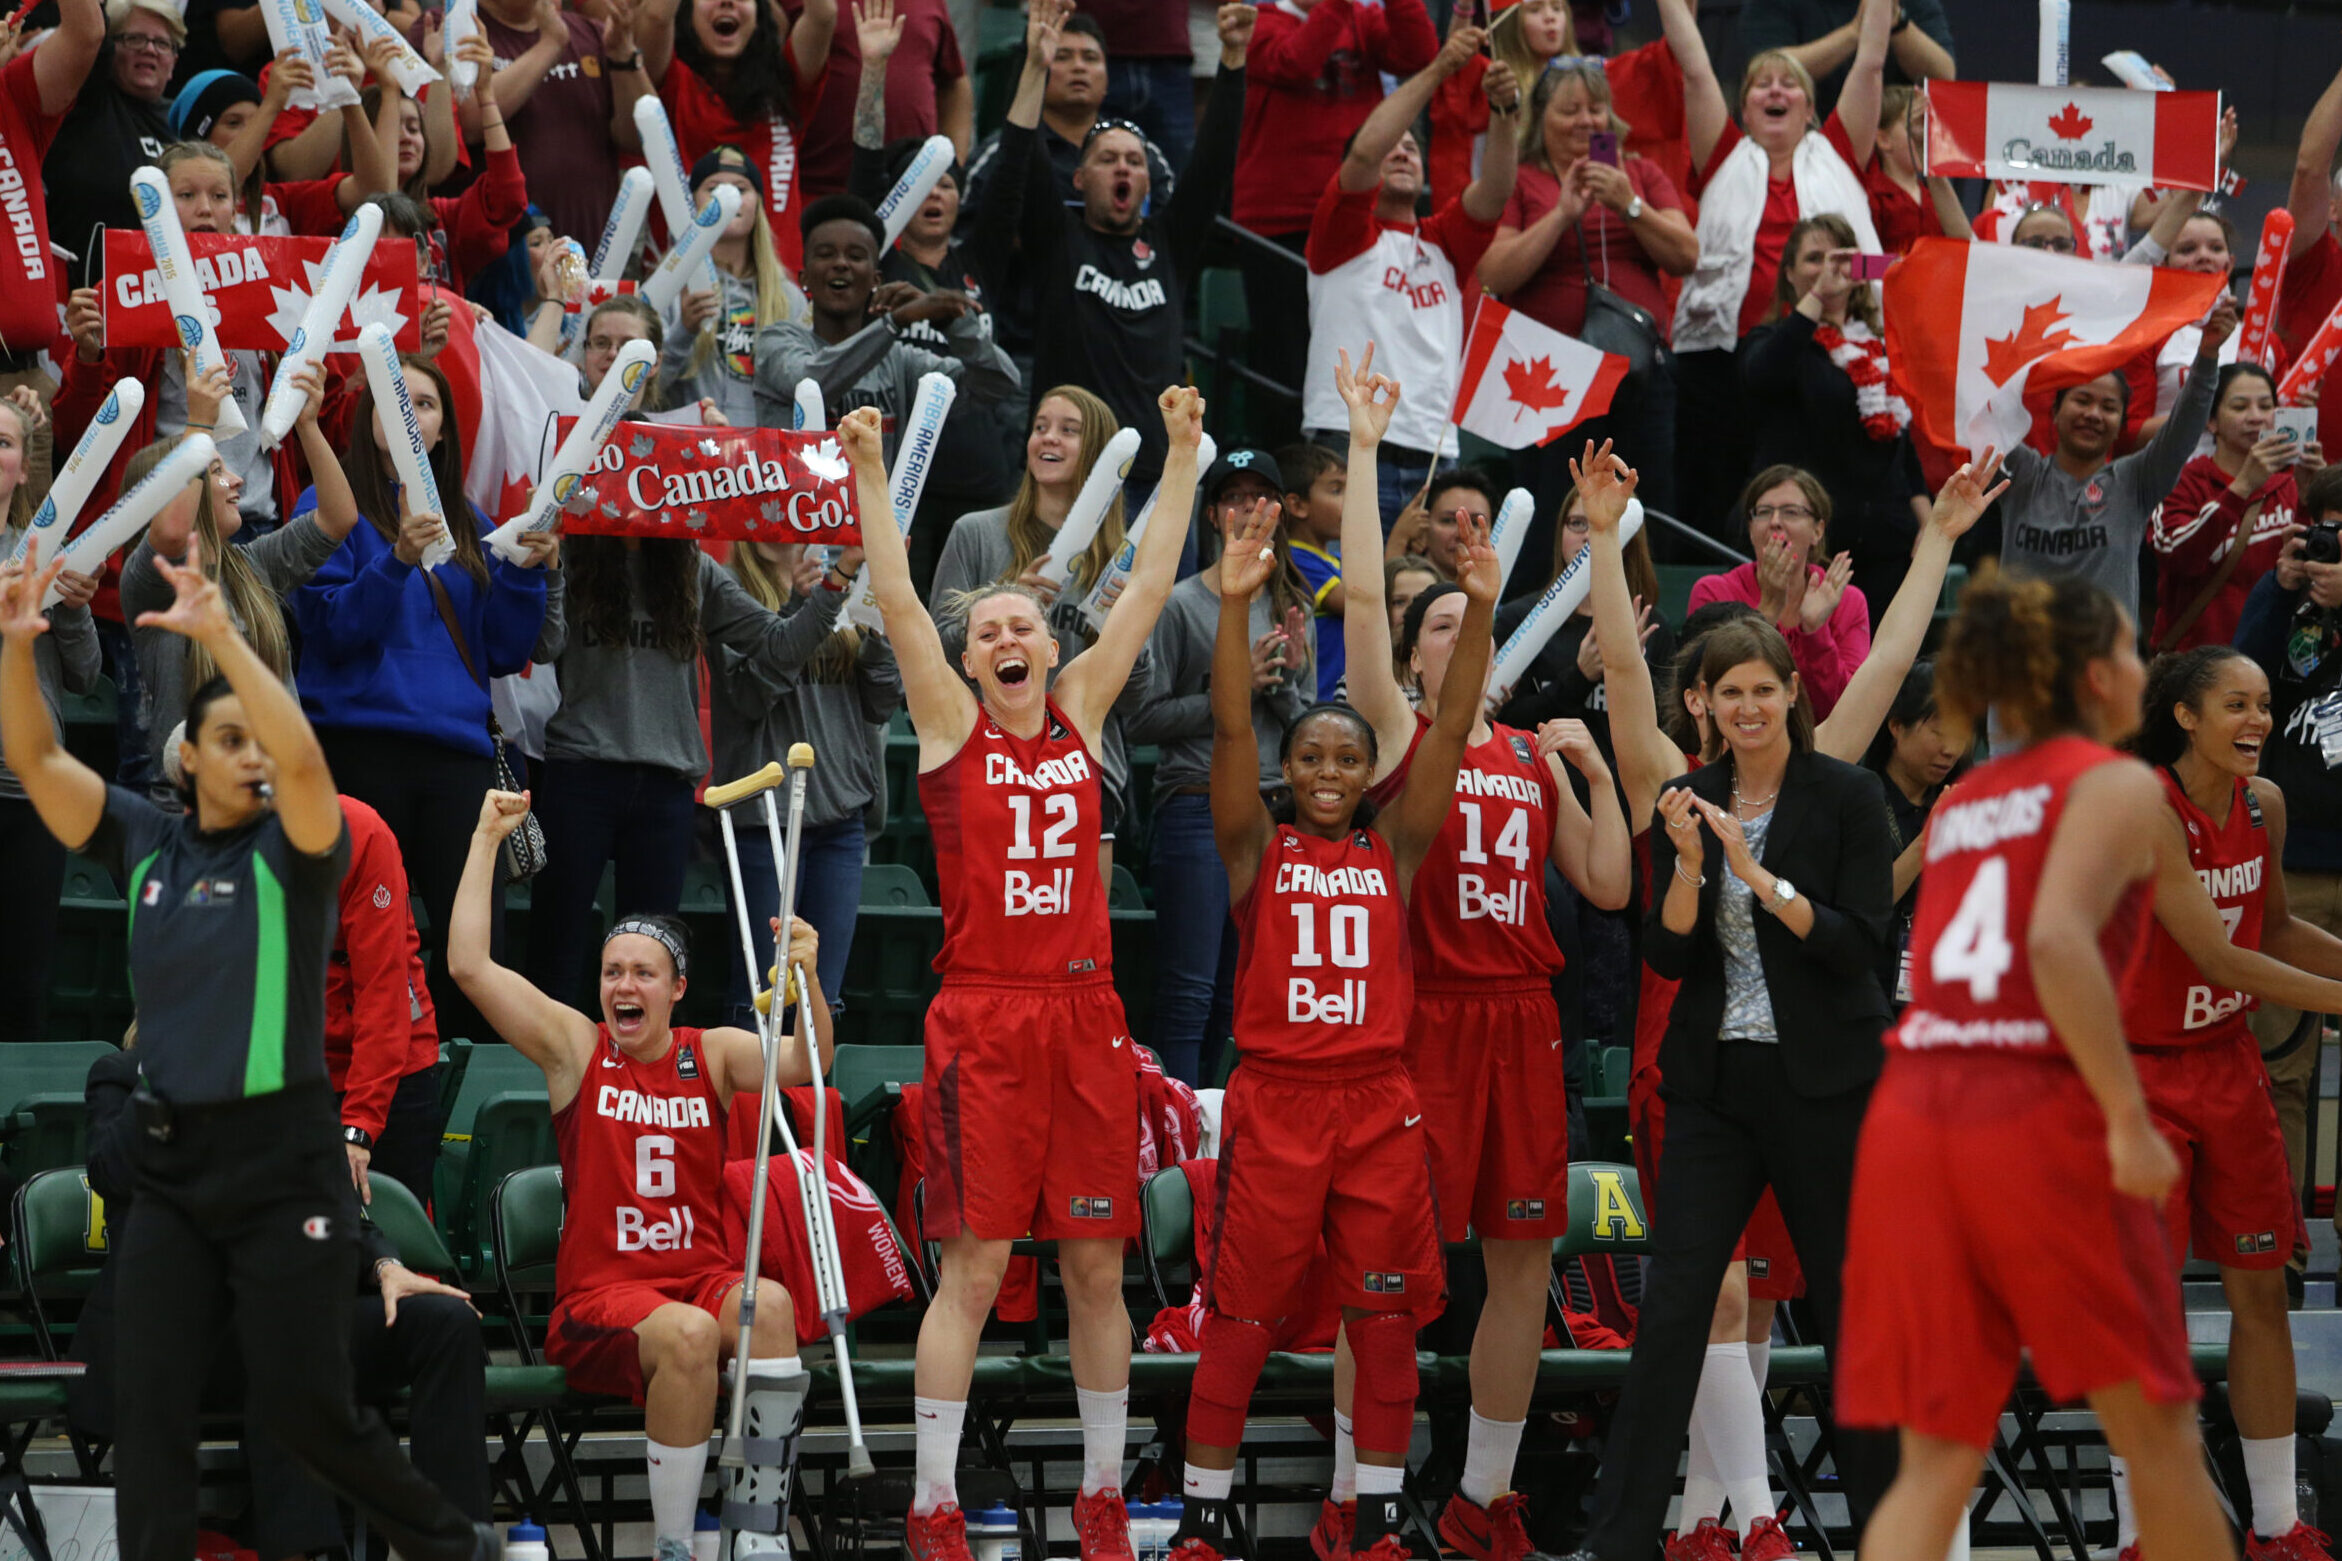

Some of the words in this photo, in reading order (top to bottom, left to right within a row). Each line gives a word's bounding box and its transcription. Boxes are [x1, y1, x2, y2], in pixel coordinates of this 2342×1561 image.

[2002, 138, 2137, 173] Canada
[115, 246, 270, 309] CAADA
[1075, 264, 1167, 311] CANADA
[627, 451, 791, 512] Canada
[787, 486, 856, 533] Go!
[2015, 523, 2108, 556] CANADA
[1455, 768, 1543, 810] ANADA
[1007, 793, 1079, 859] 12
[1459, 801, 1530, 871] 14
[1005, 867, 1074, 917] Bell
[1275, 862, 1388, 897] CANADA
[1458, 873, 1528, 926] Bell
[1291, 903, 1370, 968] 10
[1931, 854, 2013, 1002] 4
[1288, 977, 1367, 1025] Bell
[597, 1085, 710, 1128] CANADA
[635, 1135, 676, 1198] 6
[616, 1205, 694, 1252] Bell
[1587, 1169, 1647, 1241] A
